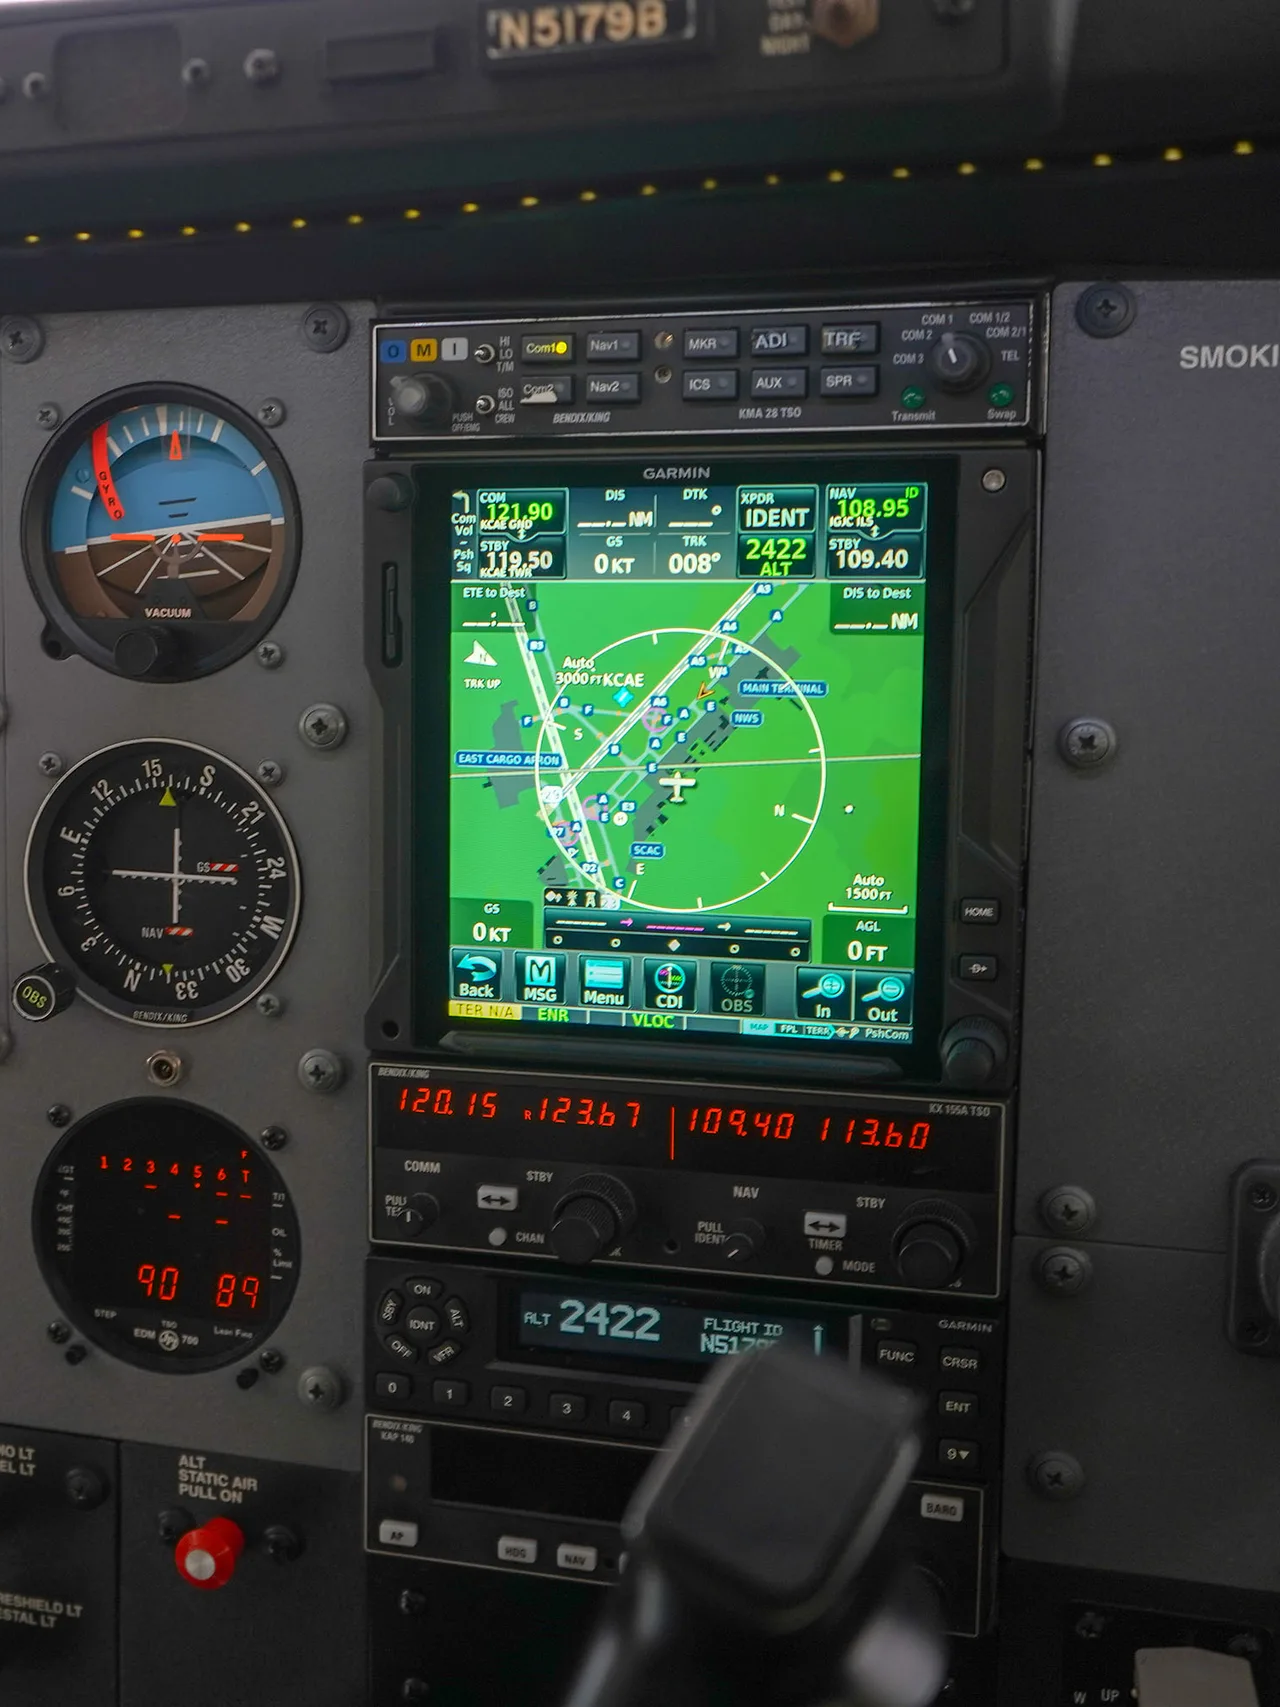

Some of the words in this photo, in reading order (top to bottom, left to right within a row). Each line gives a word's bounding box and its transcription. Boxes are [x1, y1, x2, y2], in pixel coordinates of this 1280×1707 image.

[499, 2, 668, 50] N5179B
[922, 314, 942, 325] COM
[947, 314, 953, 324] 1
[970, 313, 993, 323] COM
[995, 312, 1011, 323] 1/2
[591, 339, 619, 351] Nav1
[688, 337, 717, 350] MKR
[755, 332, 788, 349] ADI
[526, 342, 556, 355] Com1
[1001, 350, 1020, 361] TEL
[590, 381, 620, 393] Nav2
[826, 374, 853, 388] SPR
[987, 408, 1017, 422] Swap
[643, 467, 711, 481] GARMIN
[480, 492, 506, 503] COM
[605, 489, 626, 500] DIS
[740, 493, 775, 504] XPDR
[487, 502, 553, 521] 121.90
[837, 498, 910, 518] 108.95
[451, 513, 477, 524] Com
[746, 508, 810, 528] IDENT
[455, 524, 473, 536] Vol
[480, 540, 509, 552] STBY
[745, 537, 807, 559] 2422
[829, 538, 861, 550] STBY
[487, 550, 553, 570] 119.50
[835, 549, 909, 569] 109.40
[759, 561, 793, 577] ALT
[144, 607, 192, 619] VACUUM
[562, 656, 595, 669] Auto
[464, 678, 485, 688] TRK
[487, 678, 501, 689] UP
[603, 672, 644, 688] KCAE
[734, 713, 759, 724] NWS
[458, 753, 485, 764] EAST
[486, 753, 522, 765] CARGO
[141, 758, 163, 778] 15
[91, 778, 114, 802] 12
[240, 800, 266, 825] 21
[633, 845, 661, 856] SCAC
[853, 873, 885, 886] Auto
[845, 887, 878, 900] 1500
[879, 890, 892, 901] FT
[963, 906, 994, 917] HOME
[141, 927, 164, 939] NAV
[855, 920, 881, 932] AGL
[21, 985, 48, 1008] OBS
[459, 982, 495, 998] Back
[524, 987, 557, 1001] MSG
[584, 990, 625, 1005] Menu
[656, 994, 683, 1009] CDI
[133, 1010, 188, 1023] BENDIX/KING
[537, 1008, 570, 1023] ENR
[631, 1013, 675, 1029] VLOC
[867, 1007, 898, 1023] Out
[688, 1107, 796, 1140] 109.40
[404, 1159, 441, 1174] COMM
[526, 1169, 554, 1183] STBY
[733, 1185, 760, 1199] NAV
[856, 1196, 886, 1210] STBY
[272, 1227, 287, 1238] OIL
[697, 1220, 725, 1234] PULL
[515, 1231, 545, 1245] CHAN
[808, 1238, 843, 1252] TIMER
[842, 1260, 876, 1274] MODE
[137, 1264, 179, 1301] 90
[413, 1284, 432, 1295] ON
[215, 1273, 260, 1309] 89
[409, 1319, 436, 1332] IDNT
[449, 1308, 464, 1329] ALT
[523, 1311, 552, 1326] ALT
[559, 1298, 661, 1342] 2422
[703, 1316, 761, 1334] FLIGHT
[763, 1322, 783, 1337] ID
[938, 1319, 993, 1333] GARMIN
[879, 1349, 915, 1363] FUNC
[942, 1355, 978, 1370] CRSR
[945, 1400, 971, 1412] ENT
[18, 1446, 35, 1461] LT
[20, 1462, 36, 1476] LT
[178, 1454, 207, 1470] ALT
[178, 1469, 229, 1488] STATIC
[232, 1476, 259, 1492] AIR
[178, 1482, 217, 1500] PULL
[220, 1489, 243, 1504] ON
[926, 1501, 957, 1517] BARO
[40, 1615, 58, 1629] LT
